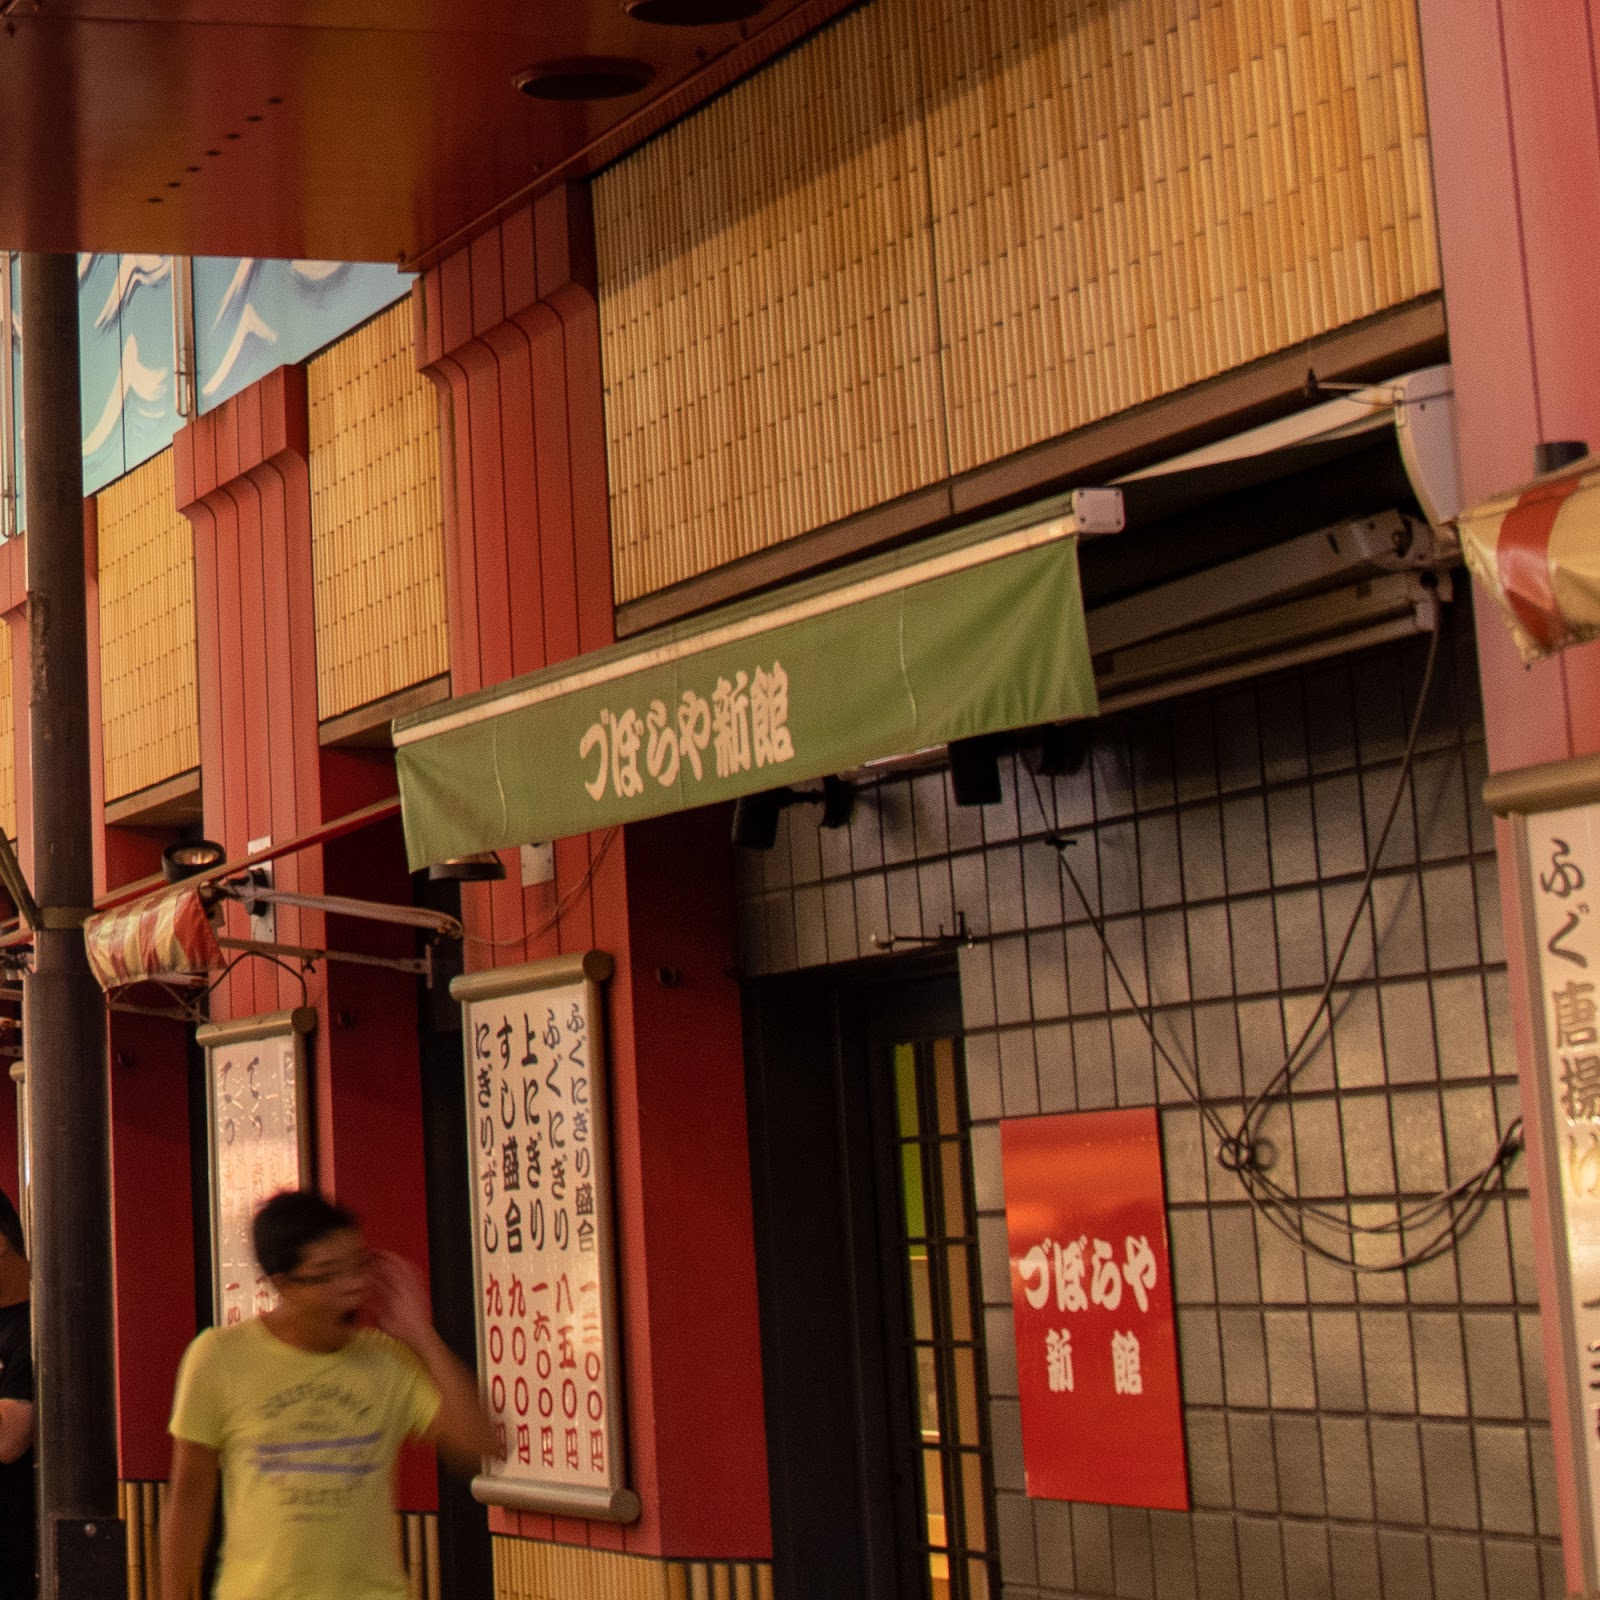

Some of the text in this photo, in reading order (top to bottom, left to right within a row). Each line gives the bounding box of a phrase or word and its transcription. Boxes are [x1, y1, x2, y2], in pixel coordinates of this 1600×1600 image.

[580, 660, 795, 802] づぼらや新館
[474, 1021, 499, 1254] にぎりずし
[496, 1015, 523, 1254] すし盛合
[521, 1012, 545, 1252] 上にぎり
[543, 1008, 569, 1252] ふぐにぎり
[566, 1002, 595, 1253] ふぐにぎり盛合
[1017, 1234, 1159, 1314] づぼらや
[1044, 1328, 1144, 1396] 新館
